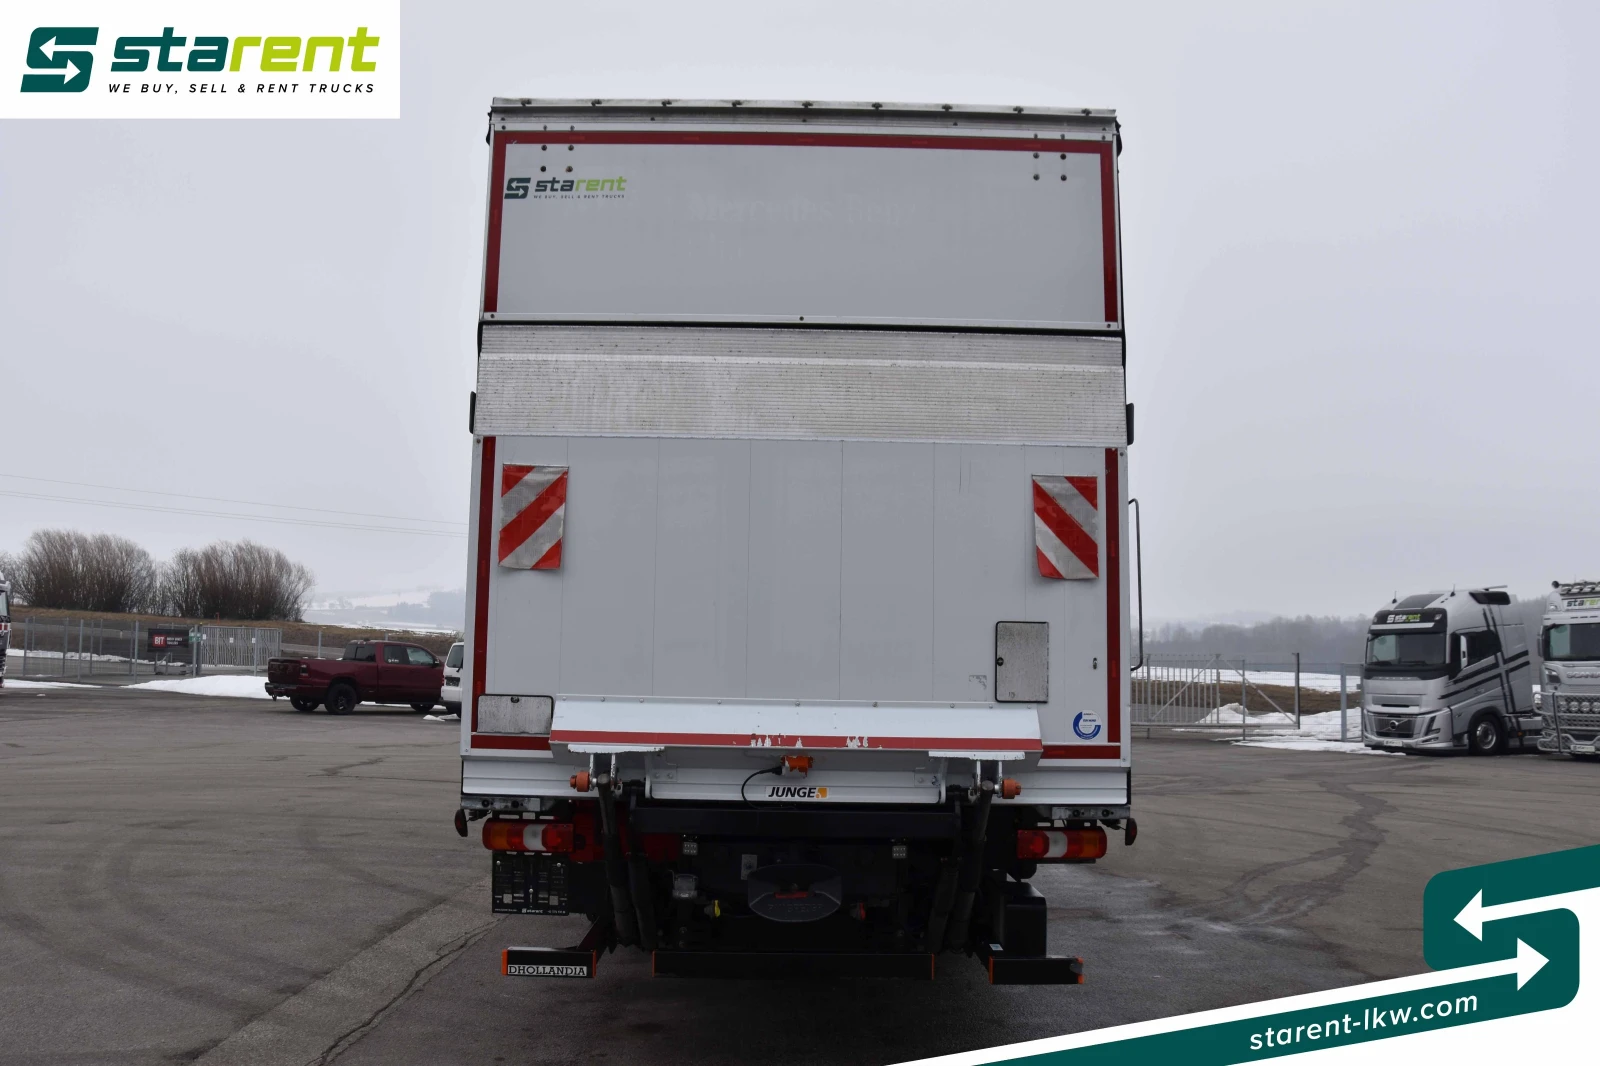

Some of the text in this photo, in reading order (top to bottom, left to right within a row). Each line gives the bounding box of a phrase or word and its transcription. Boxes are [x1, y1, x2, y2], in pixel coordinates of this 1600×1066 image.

[535, 176, 627, 192] starent
[154, 636, 164, 645] BIT
[768, 787, 816, 798] JUNGE
[508, 965, 585, 975] DHOLLANDIA
